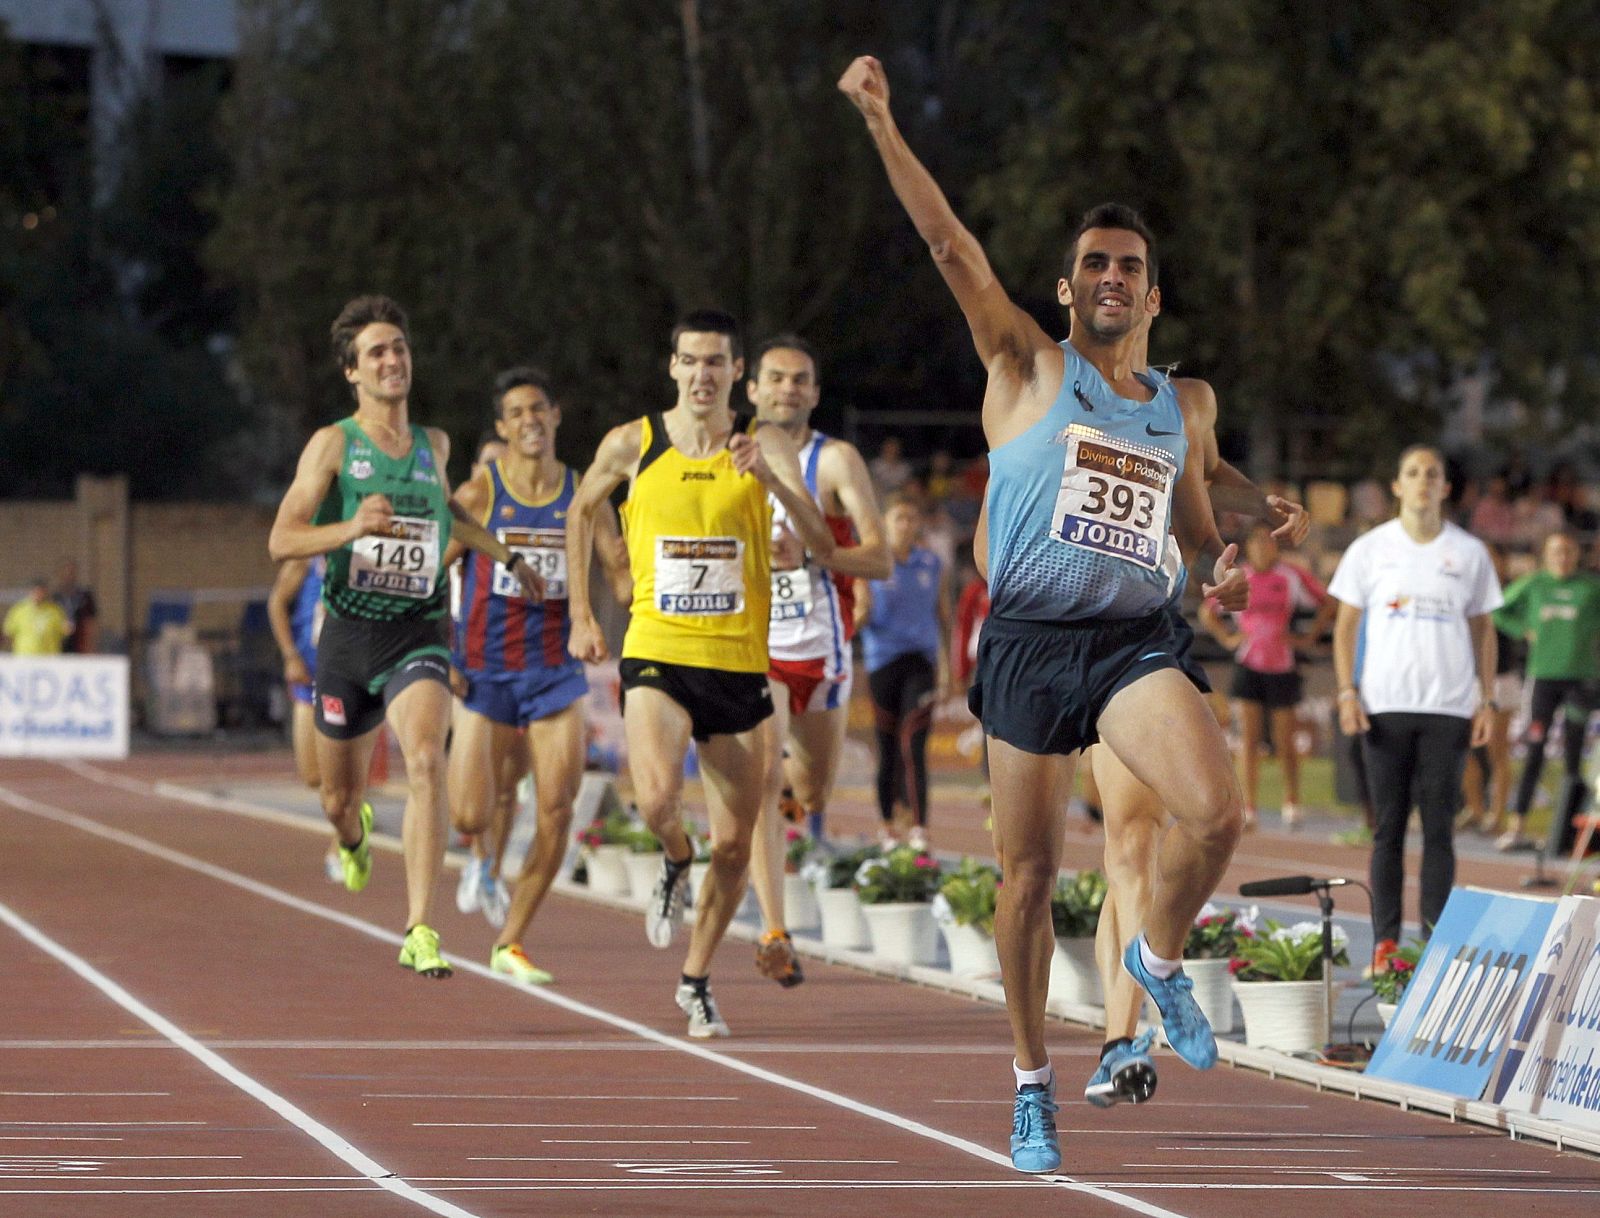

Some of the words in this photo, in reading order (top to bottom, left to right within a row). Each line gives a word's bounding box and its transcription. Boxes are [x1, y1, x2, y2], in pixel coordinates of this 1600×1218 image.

[1079, 447, 1116, 467] Divina
[1081, 476, 1156, 530] 393
[372, 543, 425, 572] 149
[692, 565, 708, 590] 7
